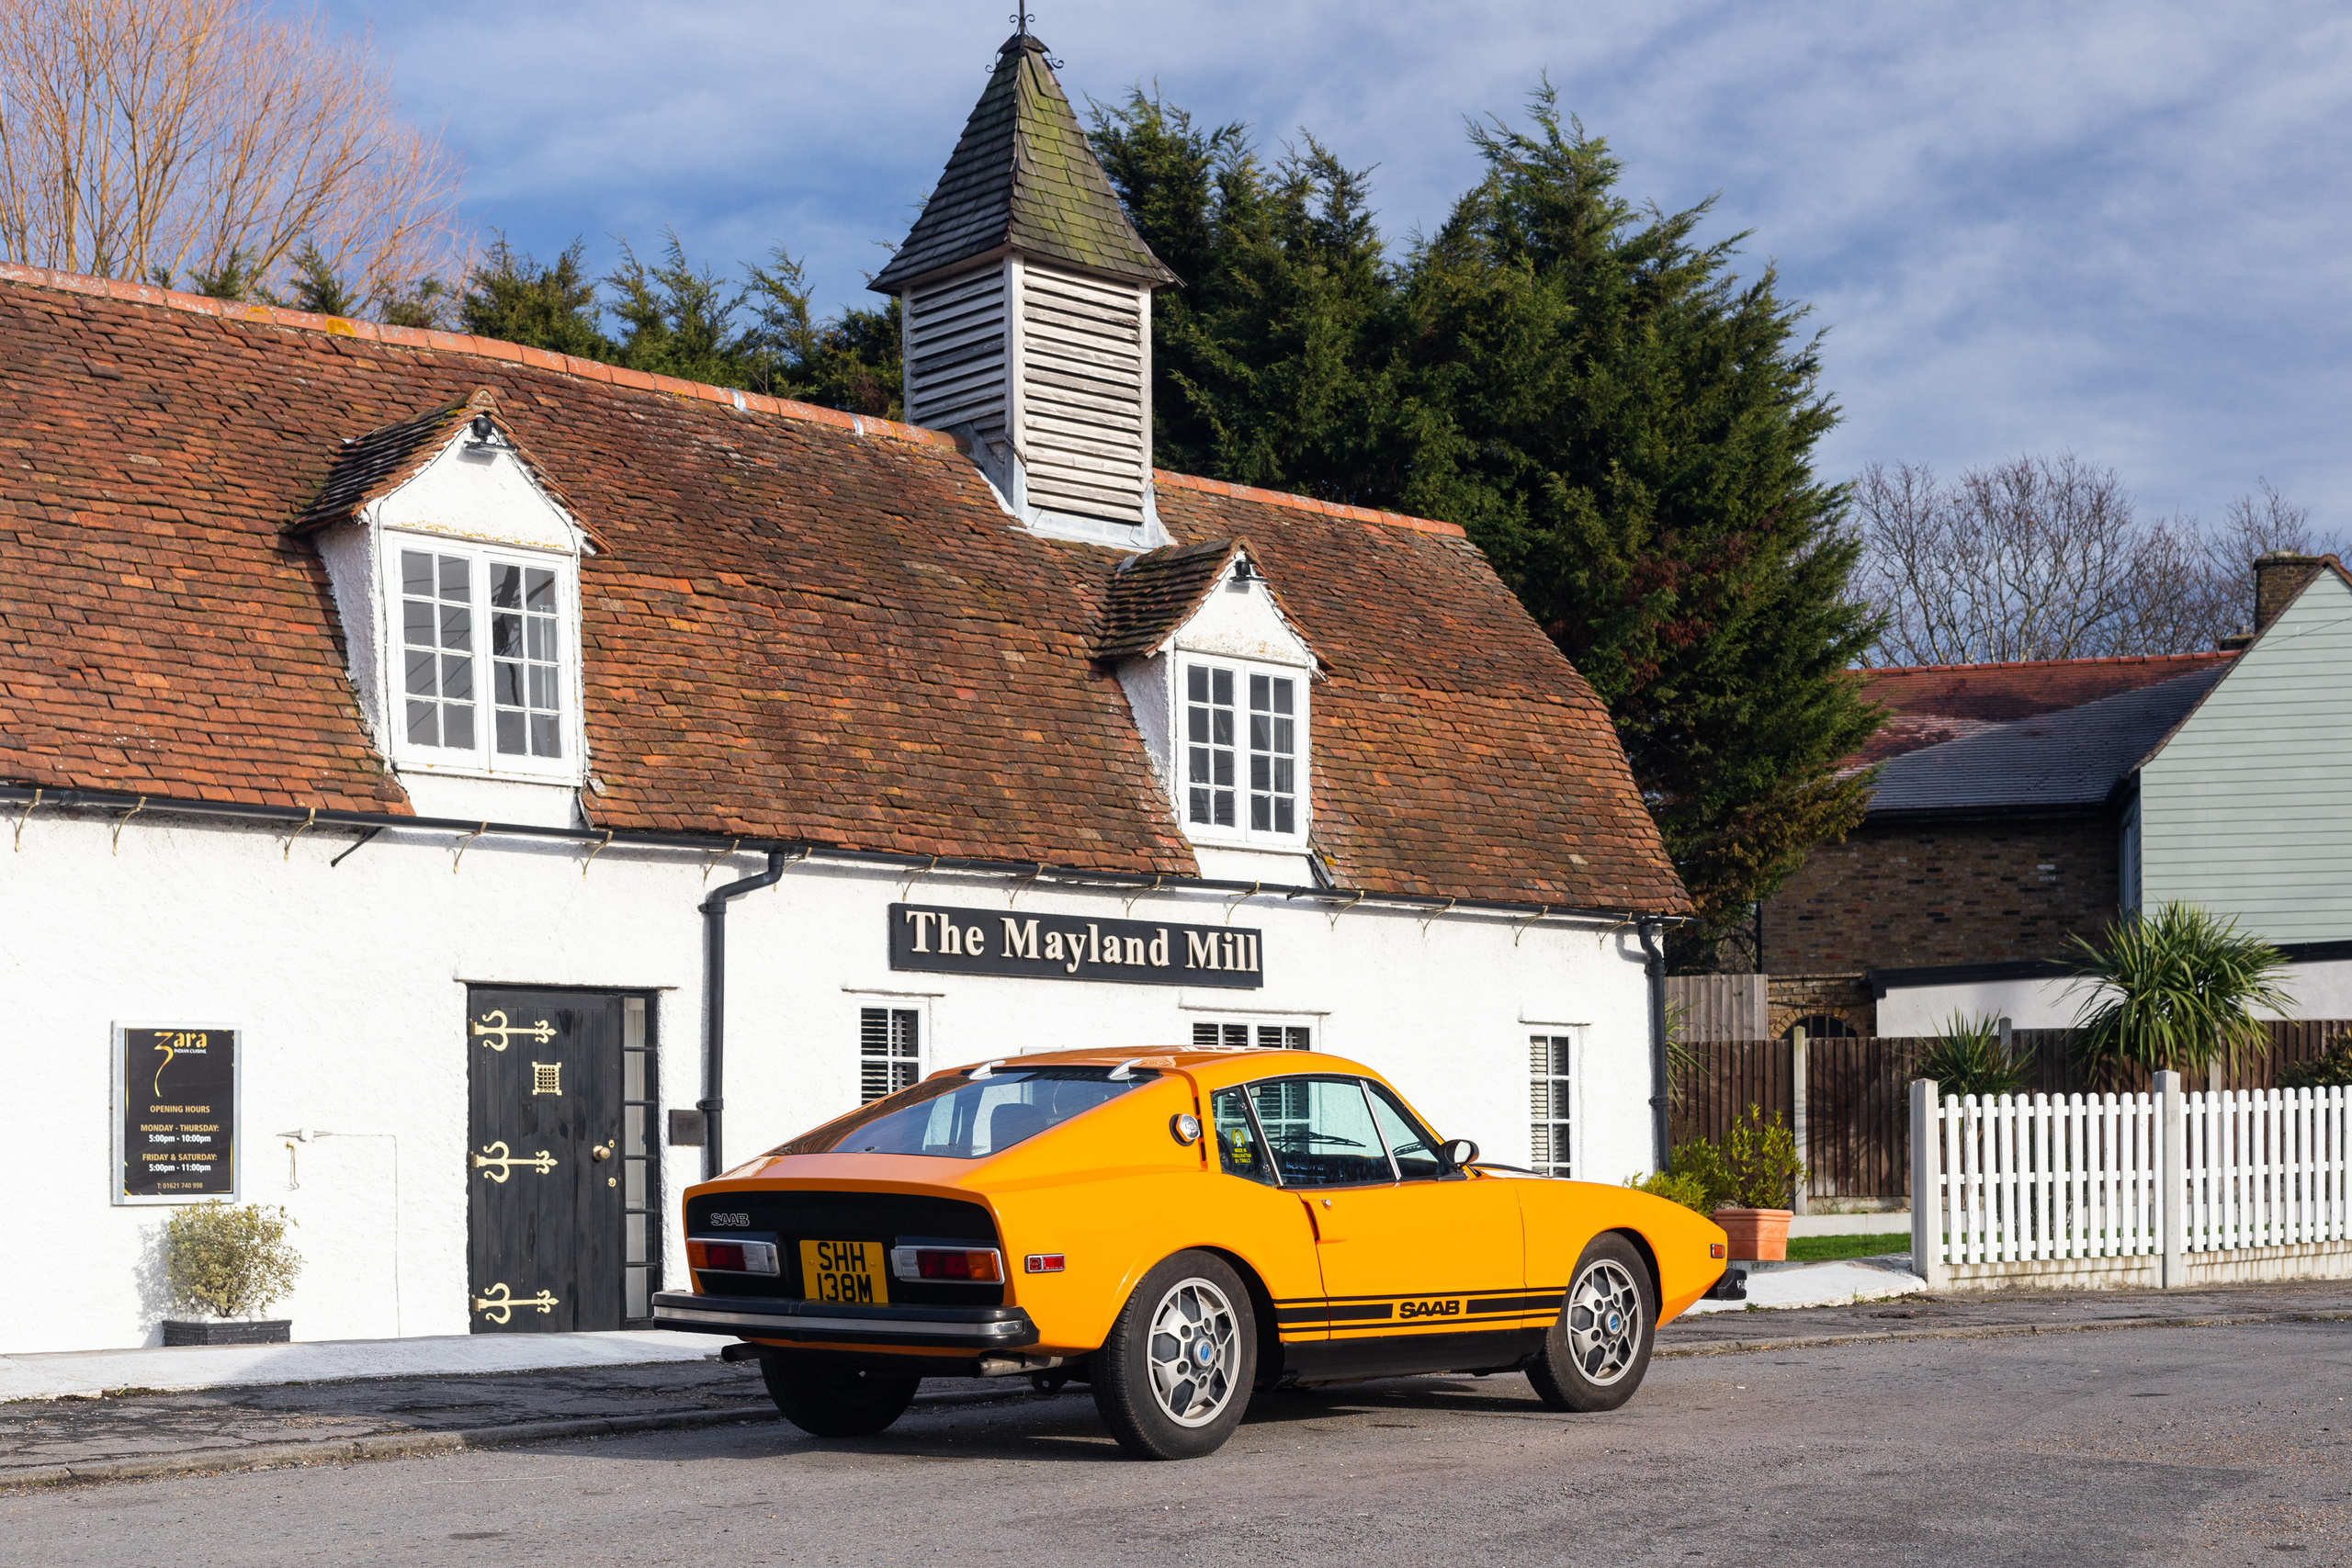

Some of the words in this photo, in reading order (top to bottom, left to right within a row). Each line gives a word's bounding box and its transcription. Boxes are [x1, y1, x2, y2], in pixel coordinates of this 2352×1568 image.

[905, 910, 985, 956] The
[1000, 917, 1170, 974] Mayland
[1182, 930, 1260, 973] Mill
[150, 1105, 184, 1113] OPENING
[185, 1105, 210, 1113] HOURS
[149, 1134, 175, 1144] 5:00pm
[181, 1134, 211, 1144] 10:00pm
[149, 1164, 175, 1173] 5:00pm
[181, 1164, 211, 1173] 11:00pm
[710, 1213, 750, 1226] SAAB
[818, 1242, 866, 1272] SHH
[817, 1273, 874, 1303] 138M
[1399, 1300, 1460, 1319] SAAB
